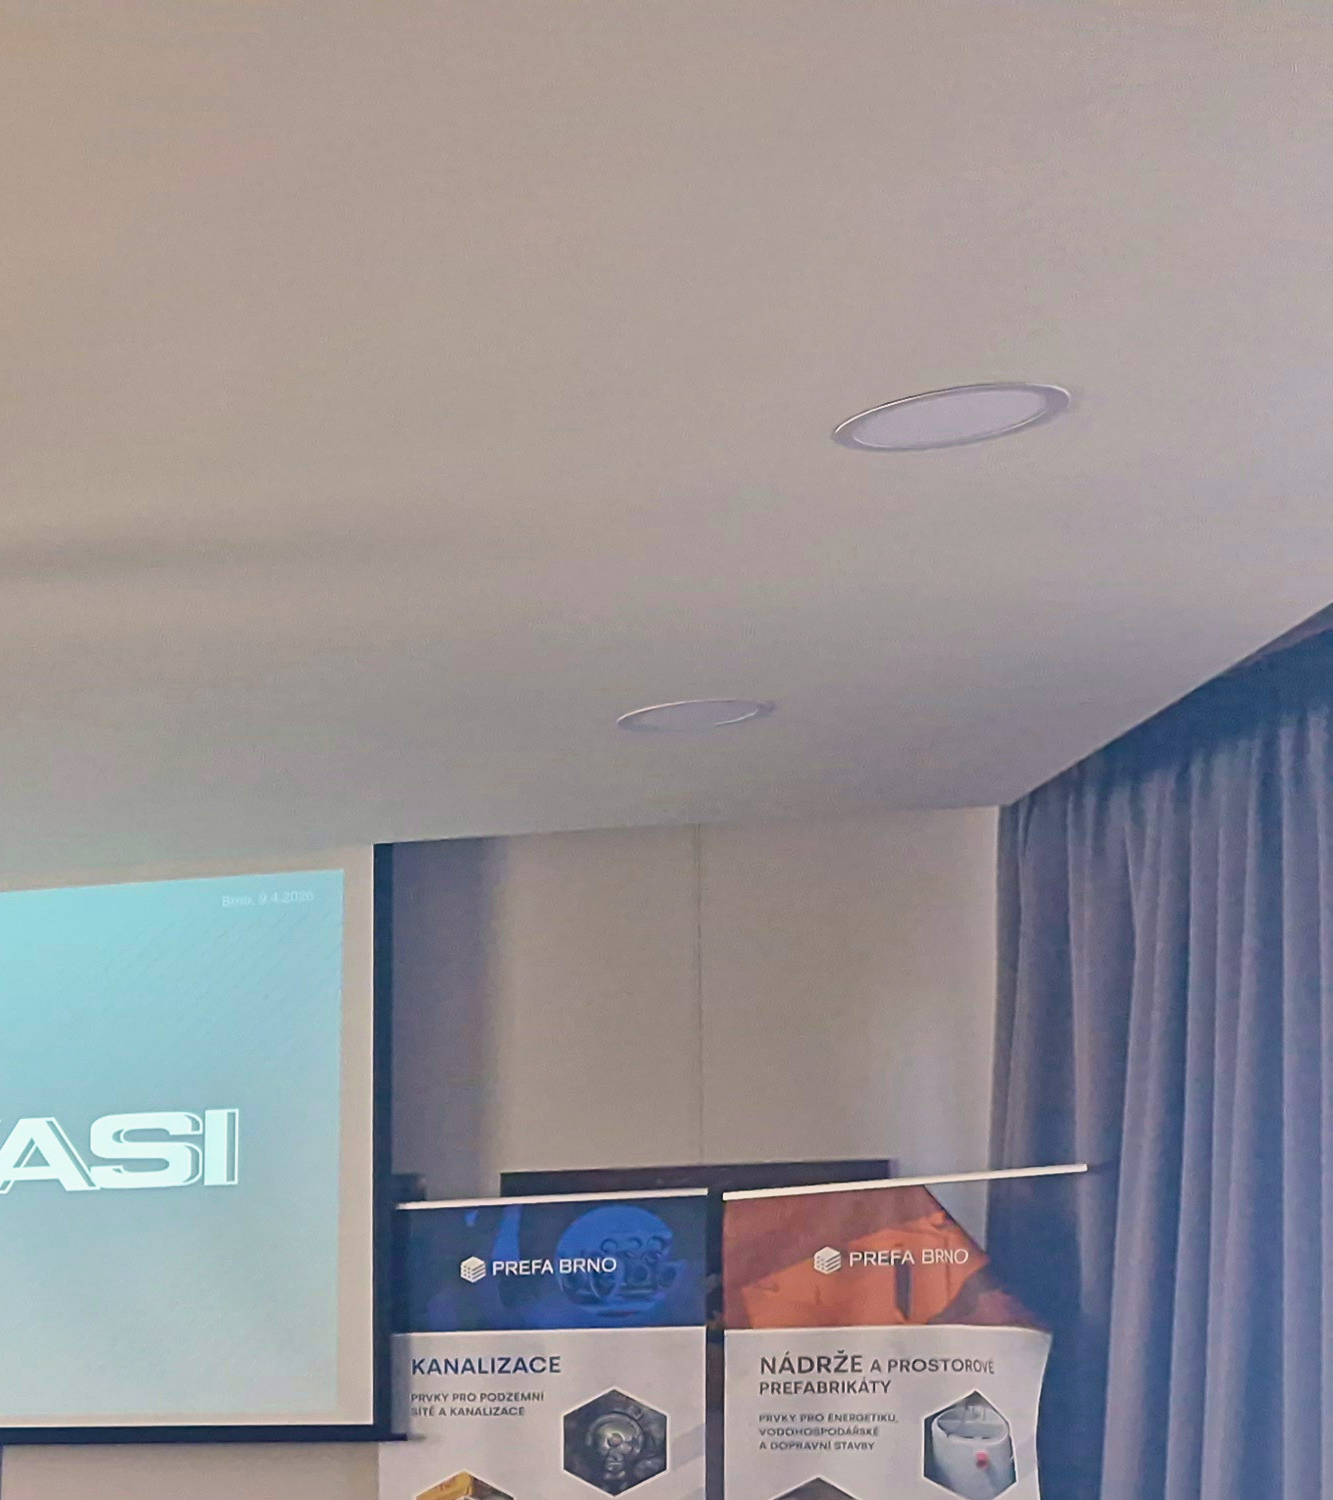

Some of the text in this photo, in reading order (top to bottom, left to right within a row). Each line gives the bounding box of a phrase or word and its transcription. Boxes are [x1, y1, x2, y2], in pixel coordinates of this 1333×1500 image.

[492, 1257, 617, 1276] PREFA BRNO
[849, 1249, 969, 1267] PREFA BRNO
[411, 1356, 562, 1375] KANALIZACE
[760, 1350, 995, 1375] NÁDRŽE A PROSTOROVÉ
[759, 1377, 892, 1395] PREFABRIKÁTY
[411, 1390, 544, 1403] PRVKY PRO PODZEMNÍ
[438, 1407, 447, 1416] A
[450, 1406, 525, 1417] KANALIZACE
